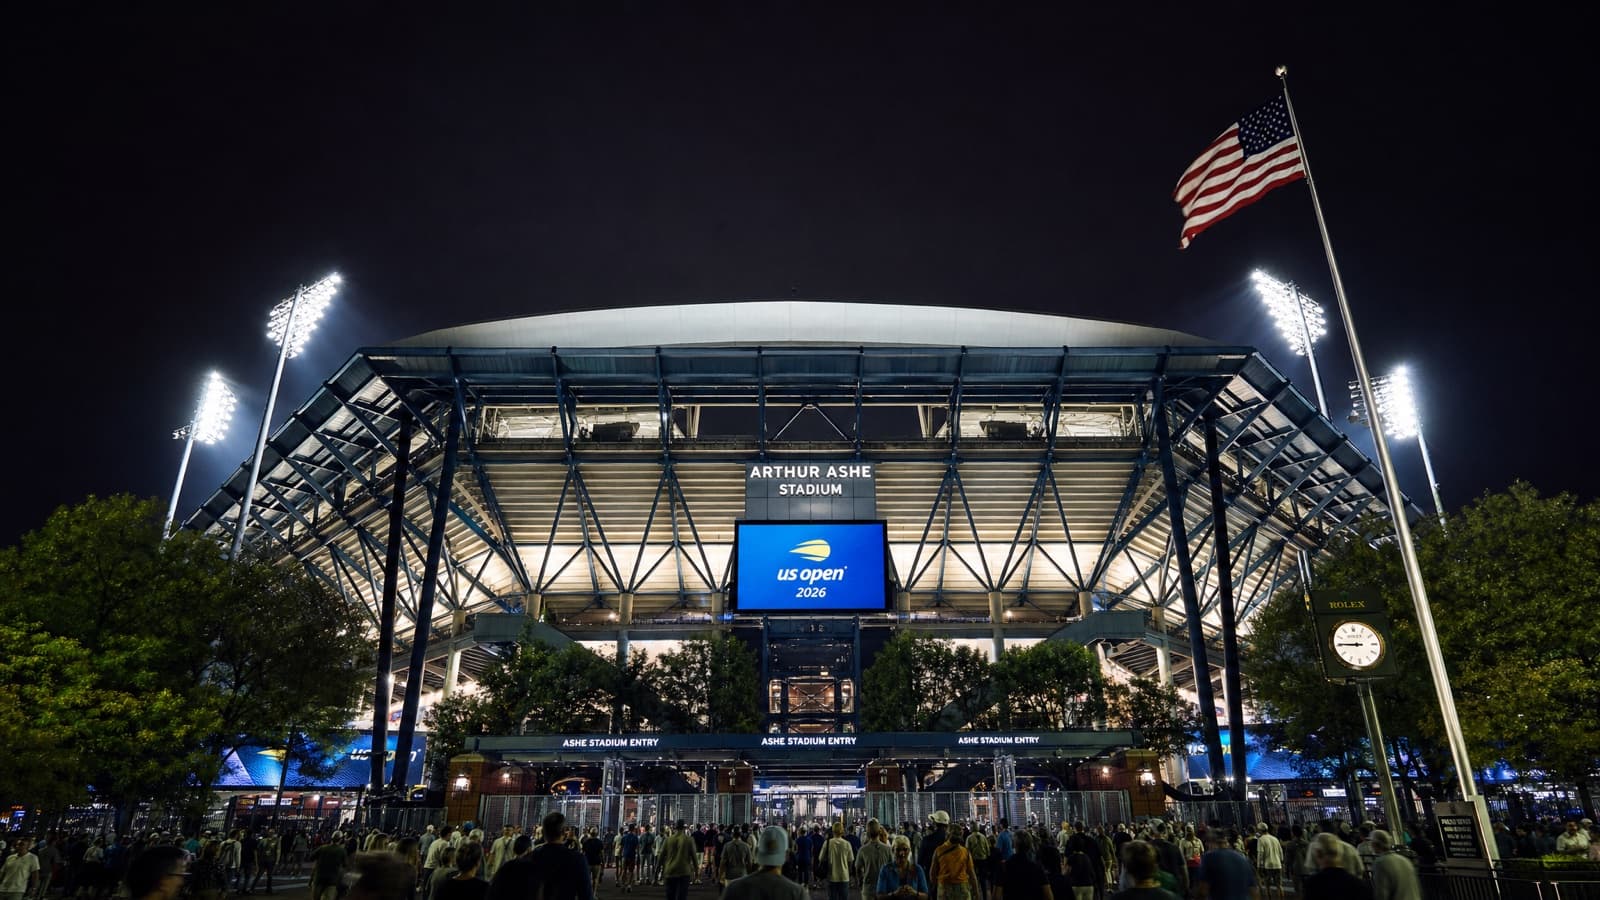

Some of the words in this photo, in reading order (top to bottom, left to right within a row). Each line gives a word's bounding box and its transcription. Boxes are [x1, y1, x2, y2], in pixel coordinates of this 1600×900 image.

[750, 465, 820, 478] ARTHUR
[826, 465, 872, 478] ASHE
[779, 484, 842, 496] STADIUM
[777, 568, 798, 581] us
[800, 568, 844, 585] open
[796, 587, 826, 598] 2026
[1329, 601, 1366, 609] ROLEX
[562, 739, 587, 748] ASHE
[589, 738, 628, 747] STADIUM
[630, 738, 659, 747] ENTRY
[761, 737, 786, 746] ASHE
[788, 737, 826, 745] STADIUM
[828, 737, 857, 745] ENTRY
[959, 736, 979, 744] ASHE
[980, 736, 1013, 744] STADIUM
[1014, 736, 1040, 744] ENTRY
